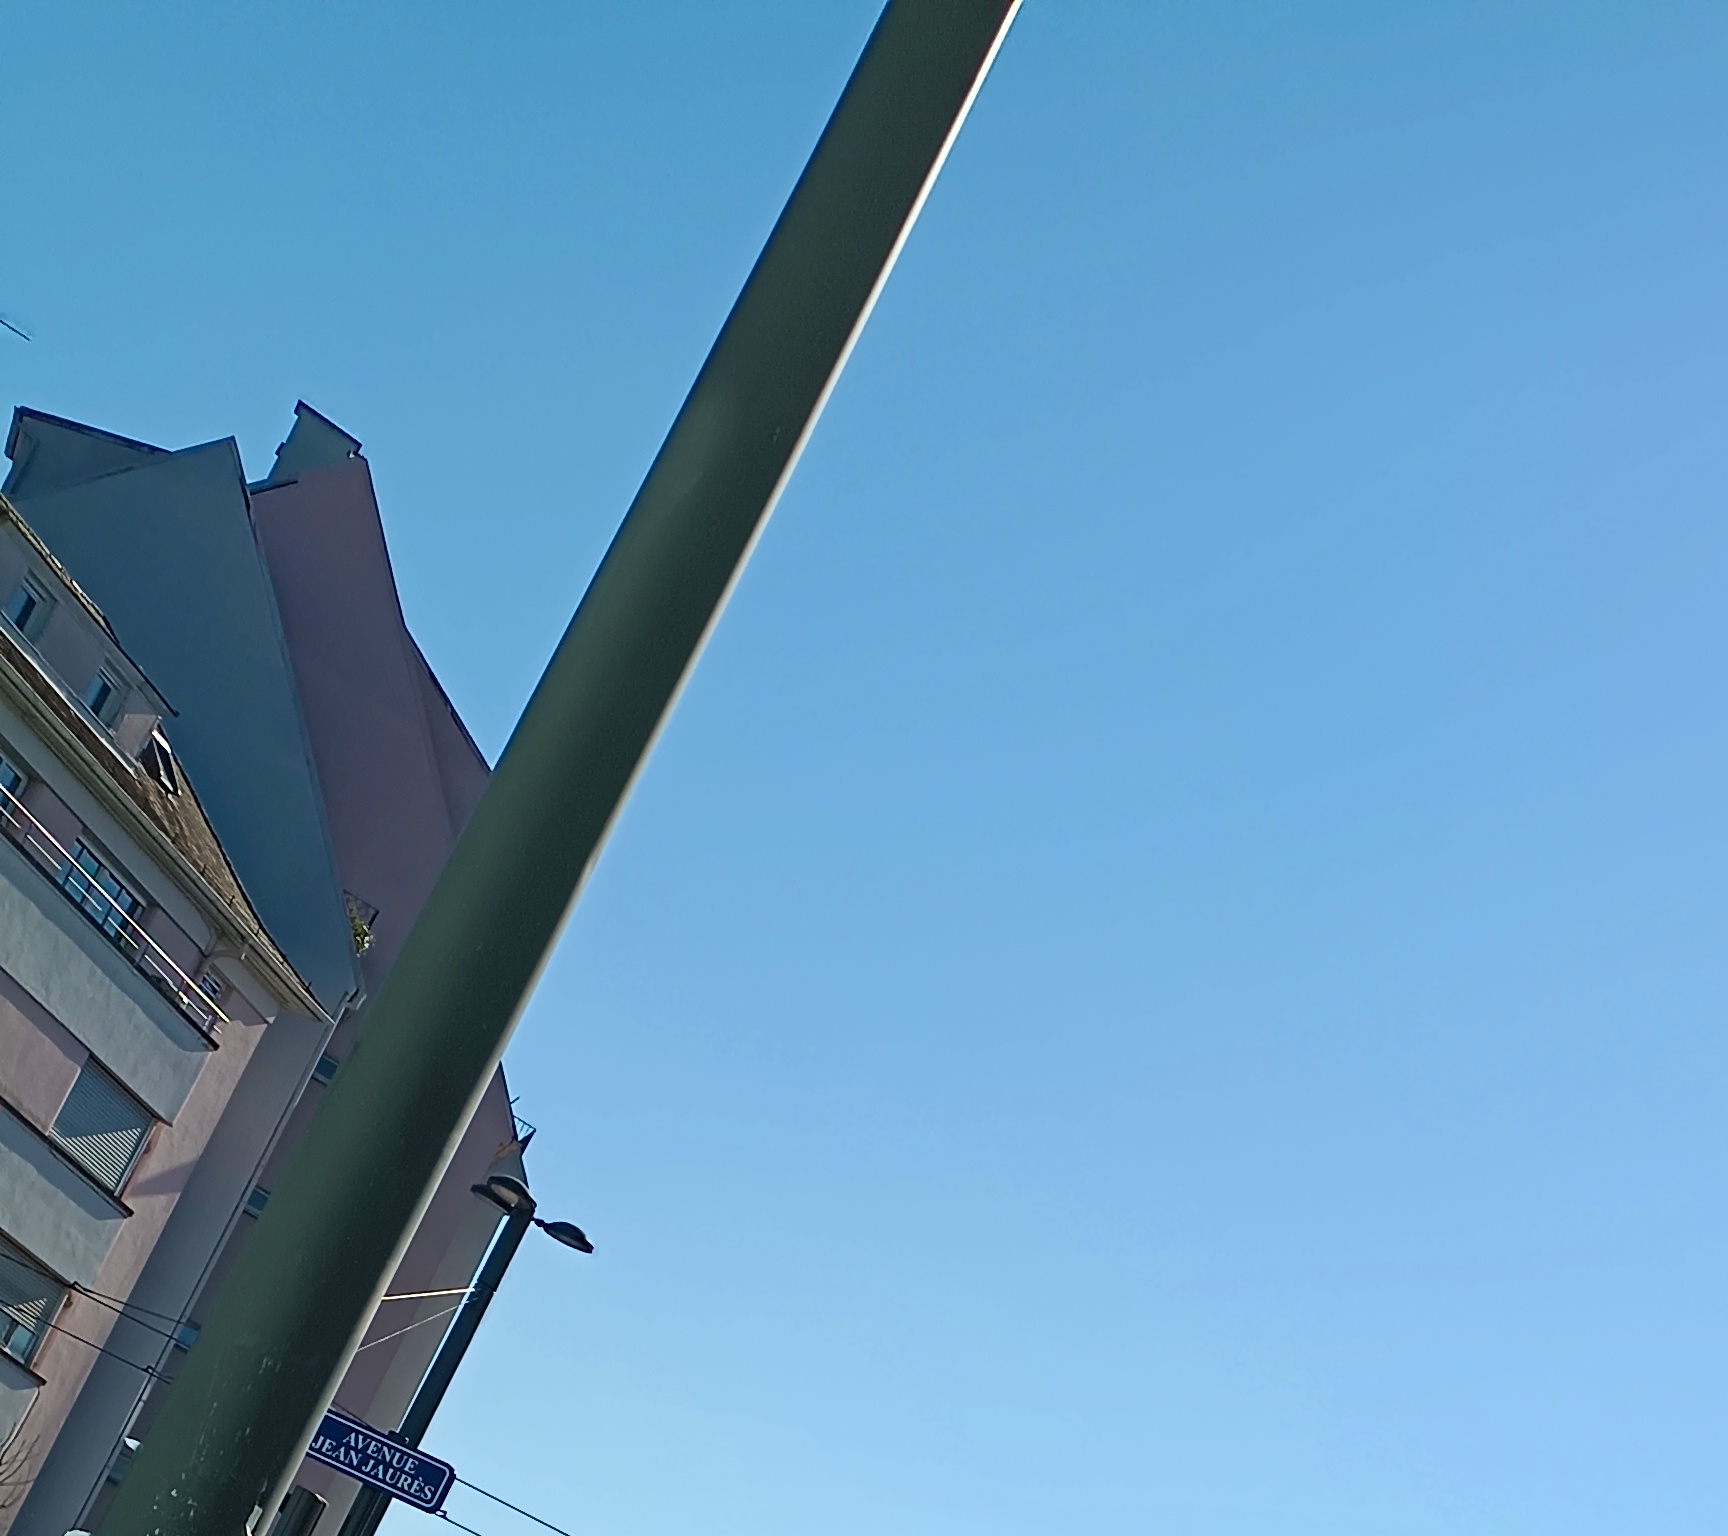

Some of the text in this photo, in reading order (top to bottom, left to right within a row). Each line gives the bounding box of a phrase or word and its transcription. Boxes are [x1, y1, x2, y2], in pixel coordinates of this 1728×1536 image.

[311, 1435, 435, 1501] JEAN JAURÈS
[343, 1431, 419, 1475] AVENUE
